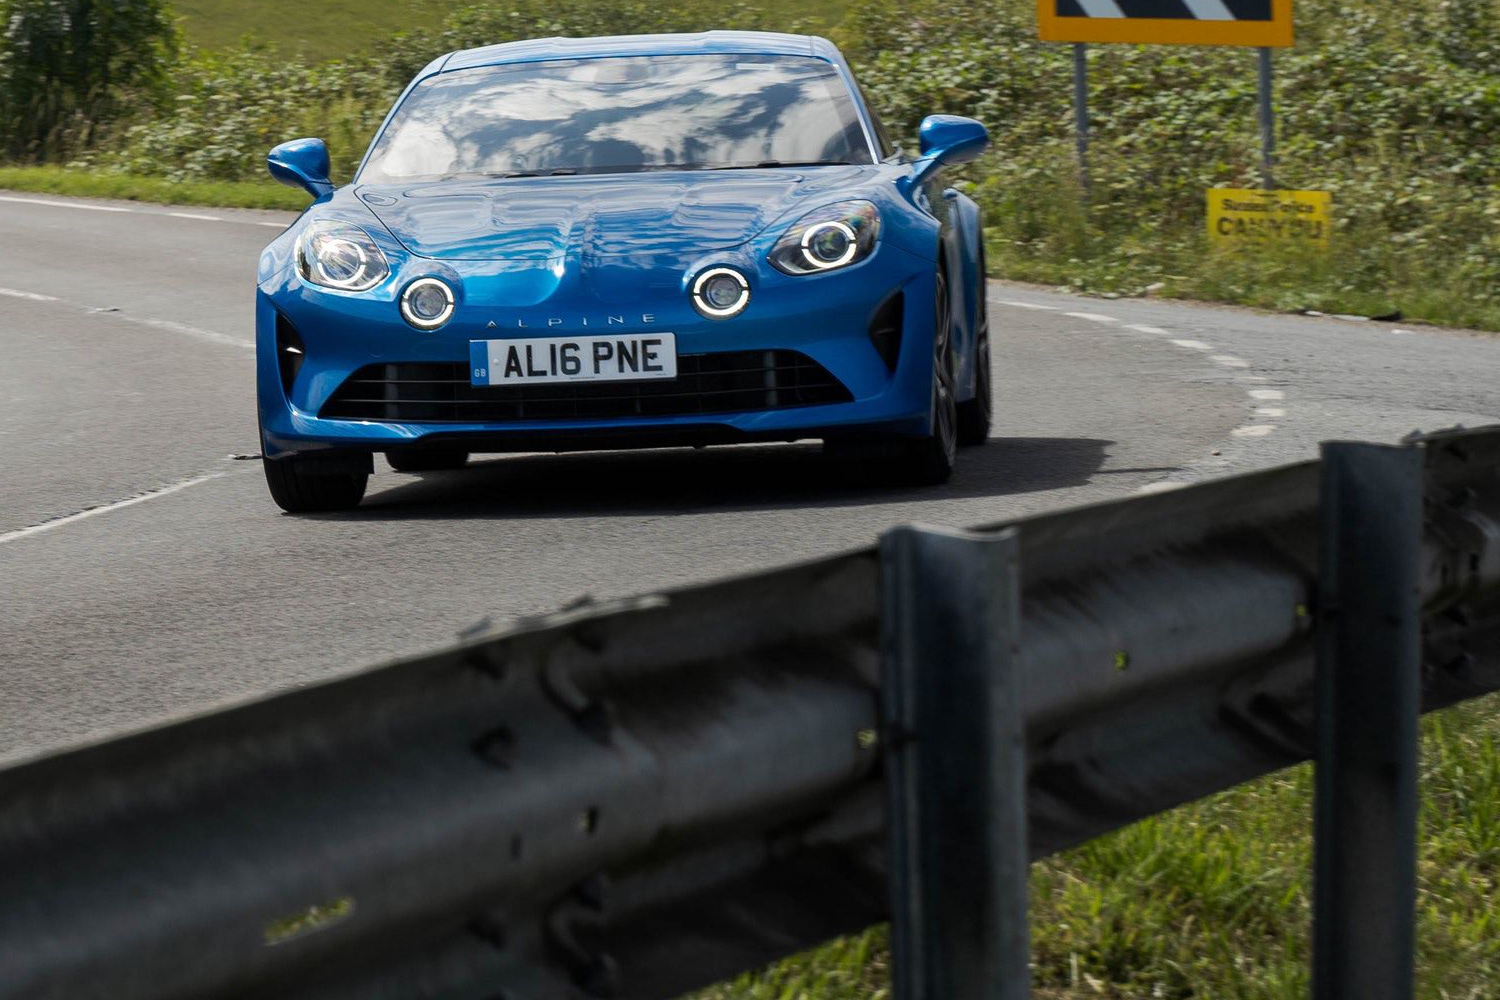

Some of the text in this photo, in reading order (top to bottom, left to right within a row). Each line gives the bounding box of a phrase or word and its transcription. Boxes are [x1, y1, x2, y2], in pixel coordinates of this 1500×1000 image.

[485, 313, 655, 328] ALPINE
[504, 339, 663, 378] AL16 PNE
[474, 368, 486, 377] GB
